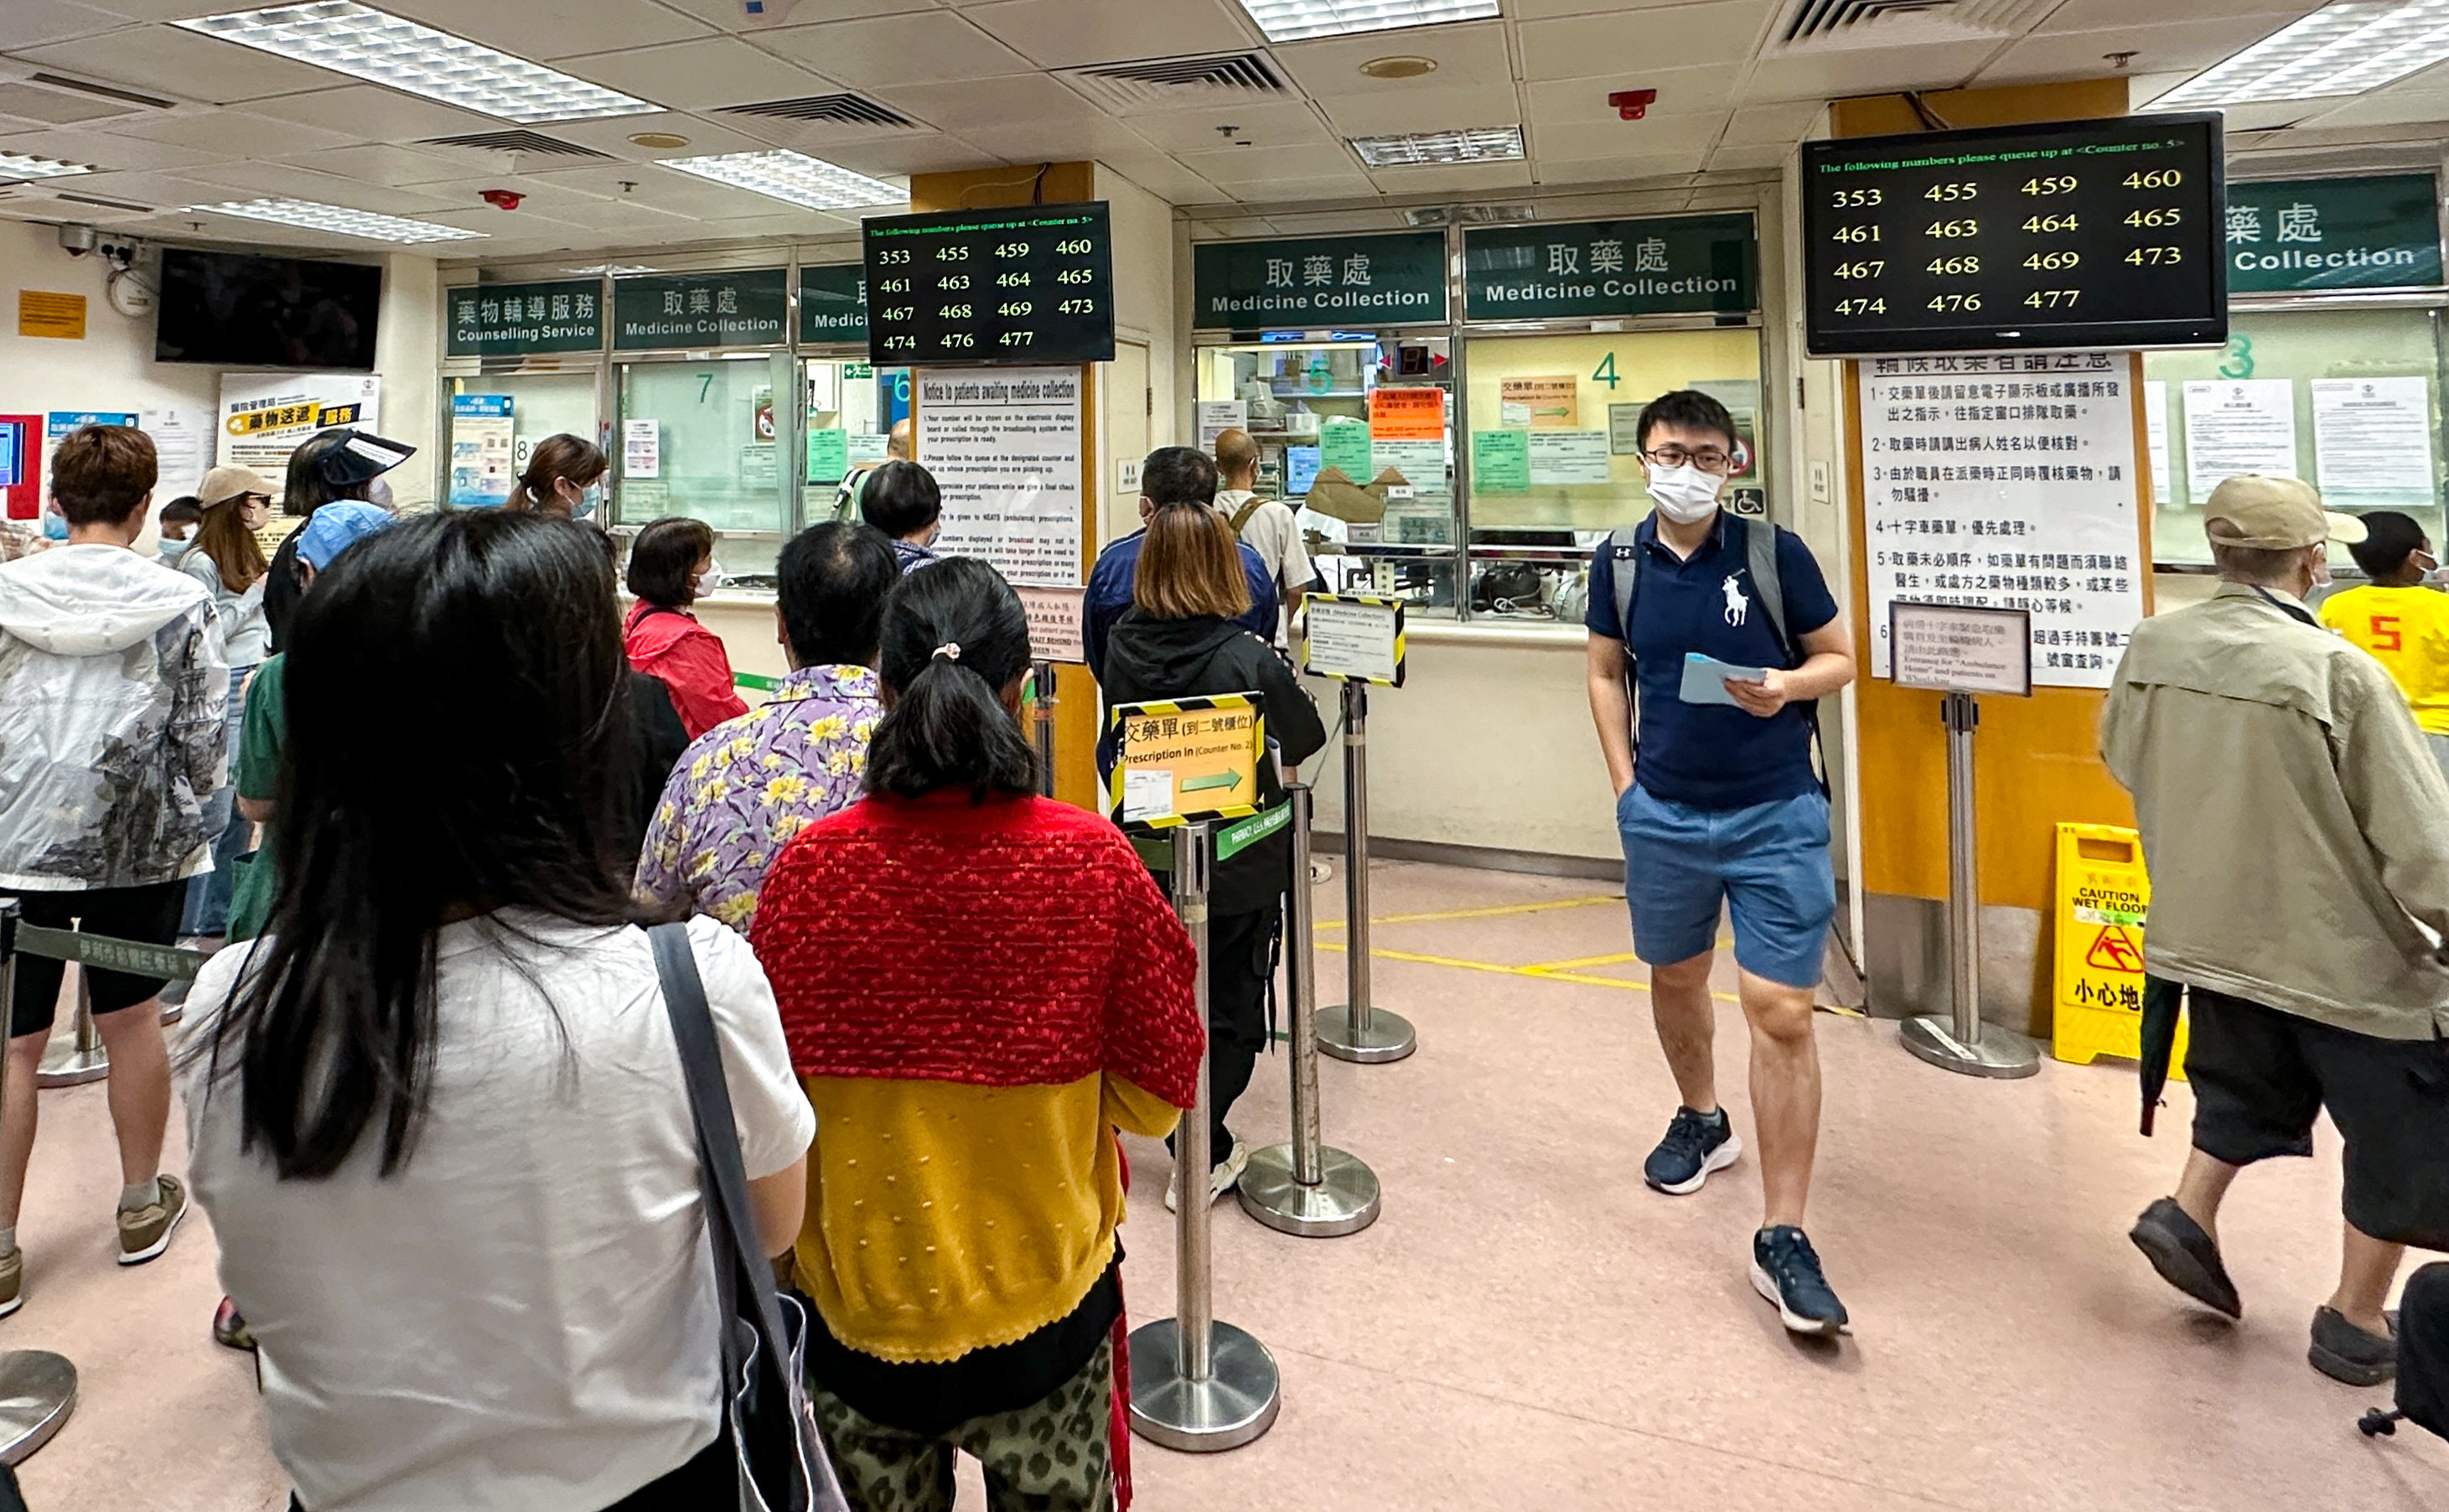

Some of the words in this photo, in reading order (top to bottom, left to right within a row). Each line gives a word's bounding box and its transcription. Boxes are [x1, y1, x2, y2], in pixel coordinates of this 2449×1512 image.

[1820, 164, 1841, 173] The
[1845, 161, 1898, 172] following
[1902, 158, 1955, 167] numbers
[1958, 154, 1995, 165] please
[2000, 151, 2037, 162] queue
[2042, 150, 2058, 158] up
[2076, 144, 2137, 153] <Counter
[1832, 189, 1882, 208] 353
[1924, 182, 1977, 203] 455
[2021, 176, 2078, 197] 459
[2122, 169, 2182, 189] 460
[886, 227, 920, 236] following
[922, 225, 954, 233] numbers
[956, 223, 979, 232] please
[981, 222, 1004, 231] queue
[1028, 217, 1064, 226] <Counter
[1833, 224, 1881, 243] 461
[1925, 218, 1977, 238] 463
[2022, 214, 2079, 234] 464
[2123, 208, 2182, 228] 465
[879, 250, 910, 265] 353
[935, 246, 969, 261] 455
[995, 243, 1029, 257] 459
[1056, 240, 1091, 254] 460
[1546, 237, 1669, 276] 取藥處
[1834, 261, 1885, 279] 467
[1926, 256, 1979, 275] 468
[2022, 251, 2079, 271] 469
[2125, 246, 2182, 266] 473
[2234, 247, 2415, 271] Collection
[881, 279, 910, 293] 461
[938, 276, 970, 290] 463
[997, 272, 1031, 287] 464
[1057, 269, 1092, 284] 465
[1266, 253, 1371, 288] 取藥處
[663, 288, 738, 315] 取藥處
[1212, 291, 1307, 312] Medicine
[1314, 288, 1429, 308] Collection
[1486, 280, 1595, 303] Medicine
[1602, 276, 1737, 297] Collection
[457, 293, 594, 325] 藥物輔導服務
[882, 308, 914, 321] 467
[939, 305, 971, 318] 468
[998, 303, 1032, 316] 469
[1059, 299, 1093, 313] 473
[1834, 297, 1887, 317] 474
[1927, 293, 1981, 313] 476
[2023, 289, 2080, 309] 477
[457, 325, 538, 342] Counselling
[541, 324, 594, 339] Service
[625, 320, 692, 336] Medicine
[697, 318, 779, 333] Collection
[883, 336, 916, 350] 474
[940, 334, 974, 348] 476
[999, 332, 1033, 345] 477
[2219, 334, 2254, 379] 3
[1310, 359, 1333, 395] 5
[1592, 352, 1620, 389] 4
[696, 374, 714, 403] 7
[894, 370, 910, 402] 6
[924, 383, 943, 400] Notice
[946, 383, 951, 400] to
[955, 382, 979, 404] patients
[982, 381, 1008, 404] awaiting
[1011, 381, 1040, 399] medicine
[1043, 380, 1074, 398] collection
[517, 441, 527, 460] 8
[1892, 488, 1939, 502] 勿騷擾。
[2370, 615, 2400, 651] 5
[1125, 717, 1179, 743] 交藥單
[1184, 748, 1193, 757] In
[1195, 745, 1228, 757] (Counter
[1230, 743, 1244, 751] No.
[2072, 897, 2098, 909] WET
[2079, 888, 2140, 904] CAUTION
